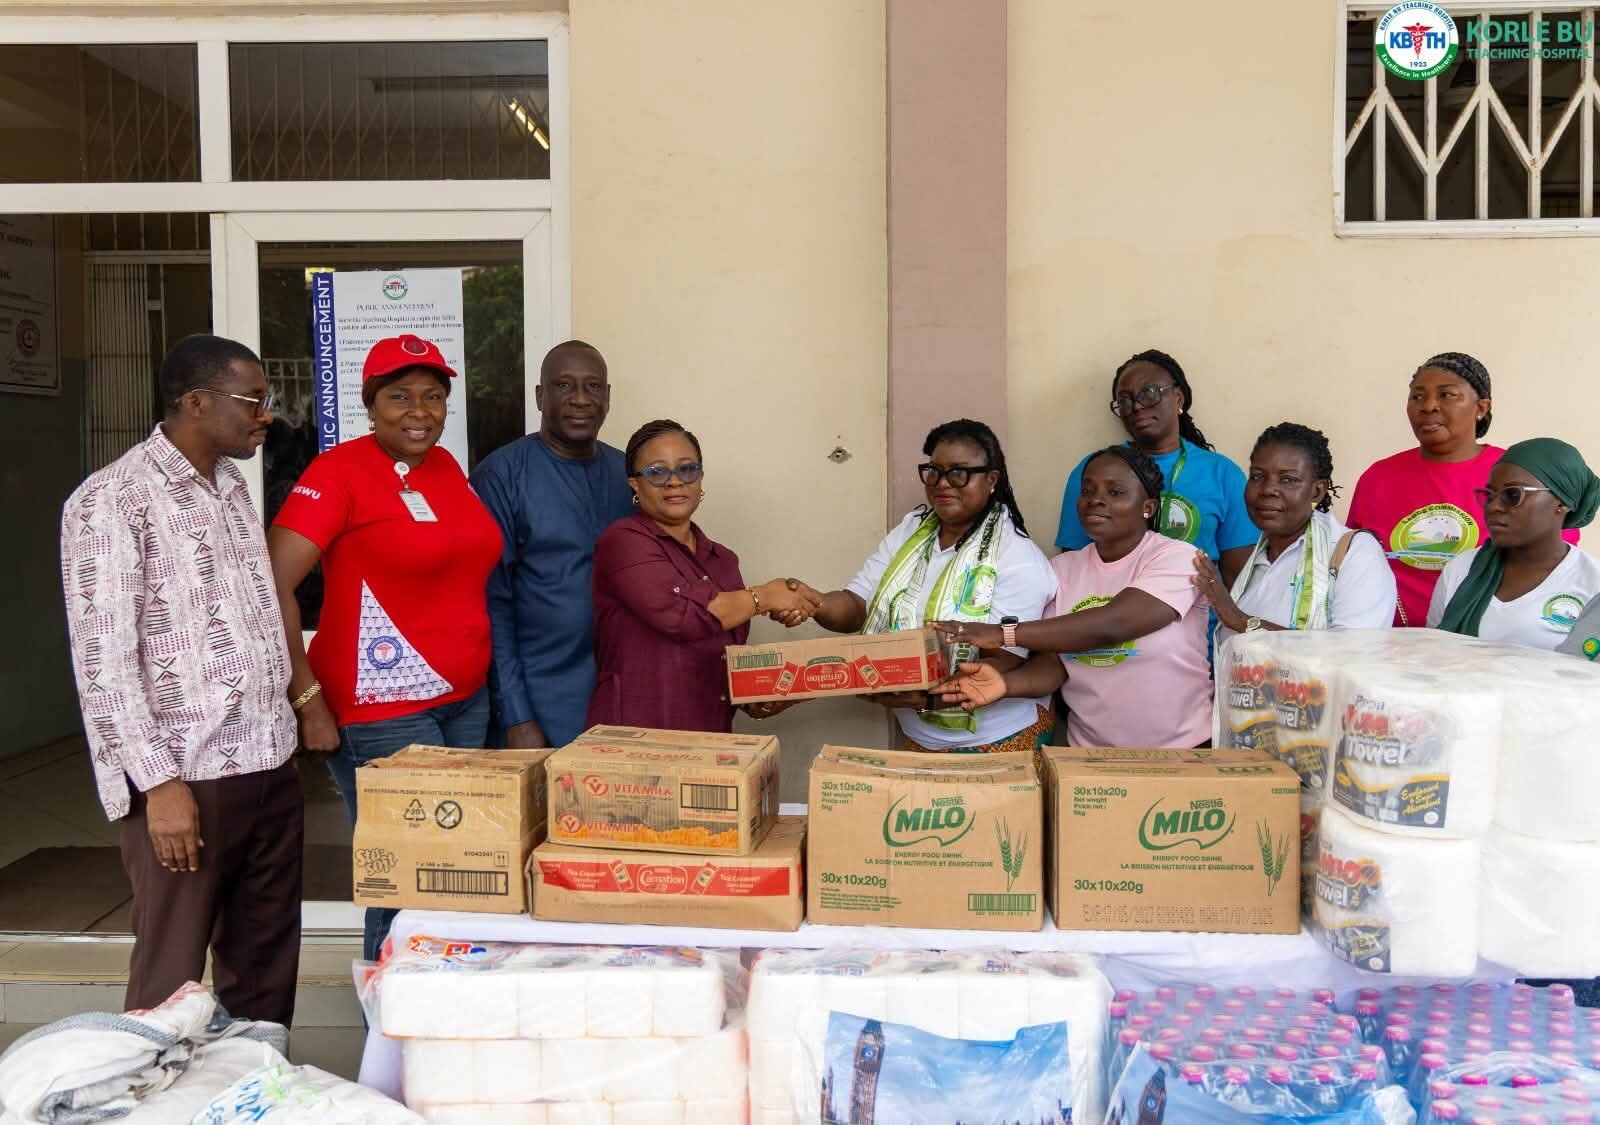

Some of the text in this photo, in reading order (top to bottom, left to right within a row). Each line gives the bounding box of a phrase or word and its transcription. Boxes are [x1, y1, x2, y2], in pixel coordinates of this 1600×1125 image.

[356, 303, 434, 312] PUBLIC ANNOUNCEMENT
[316, 277, 335, 418] ANNOUNCEMENT
[614, 783, 673, 796] VITAMILK
[821, 781, 873, 793] 30x10x20g
[1073, 786, 1127, 798] 30x10x20g
[410, 808, 421, 816] 20
[894, 806, 967, 833] MILO
[1151, 808, 1226, 836] MILO
[586, 822, 640, 834] VITAMILK
[1130, 863, 1161, 871] BOISSON
[1161, 863, 1197, 871] NUTRITIVE
[639, 869, 685, 888] Carnation
[820, 872, 887, 888] 30x10x20g
[1073, 879, 1143, 894] 30x10x20g
